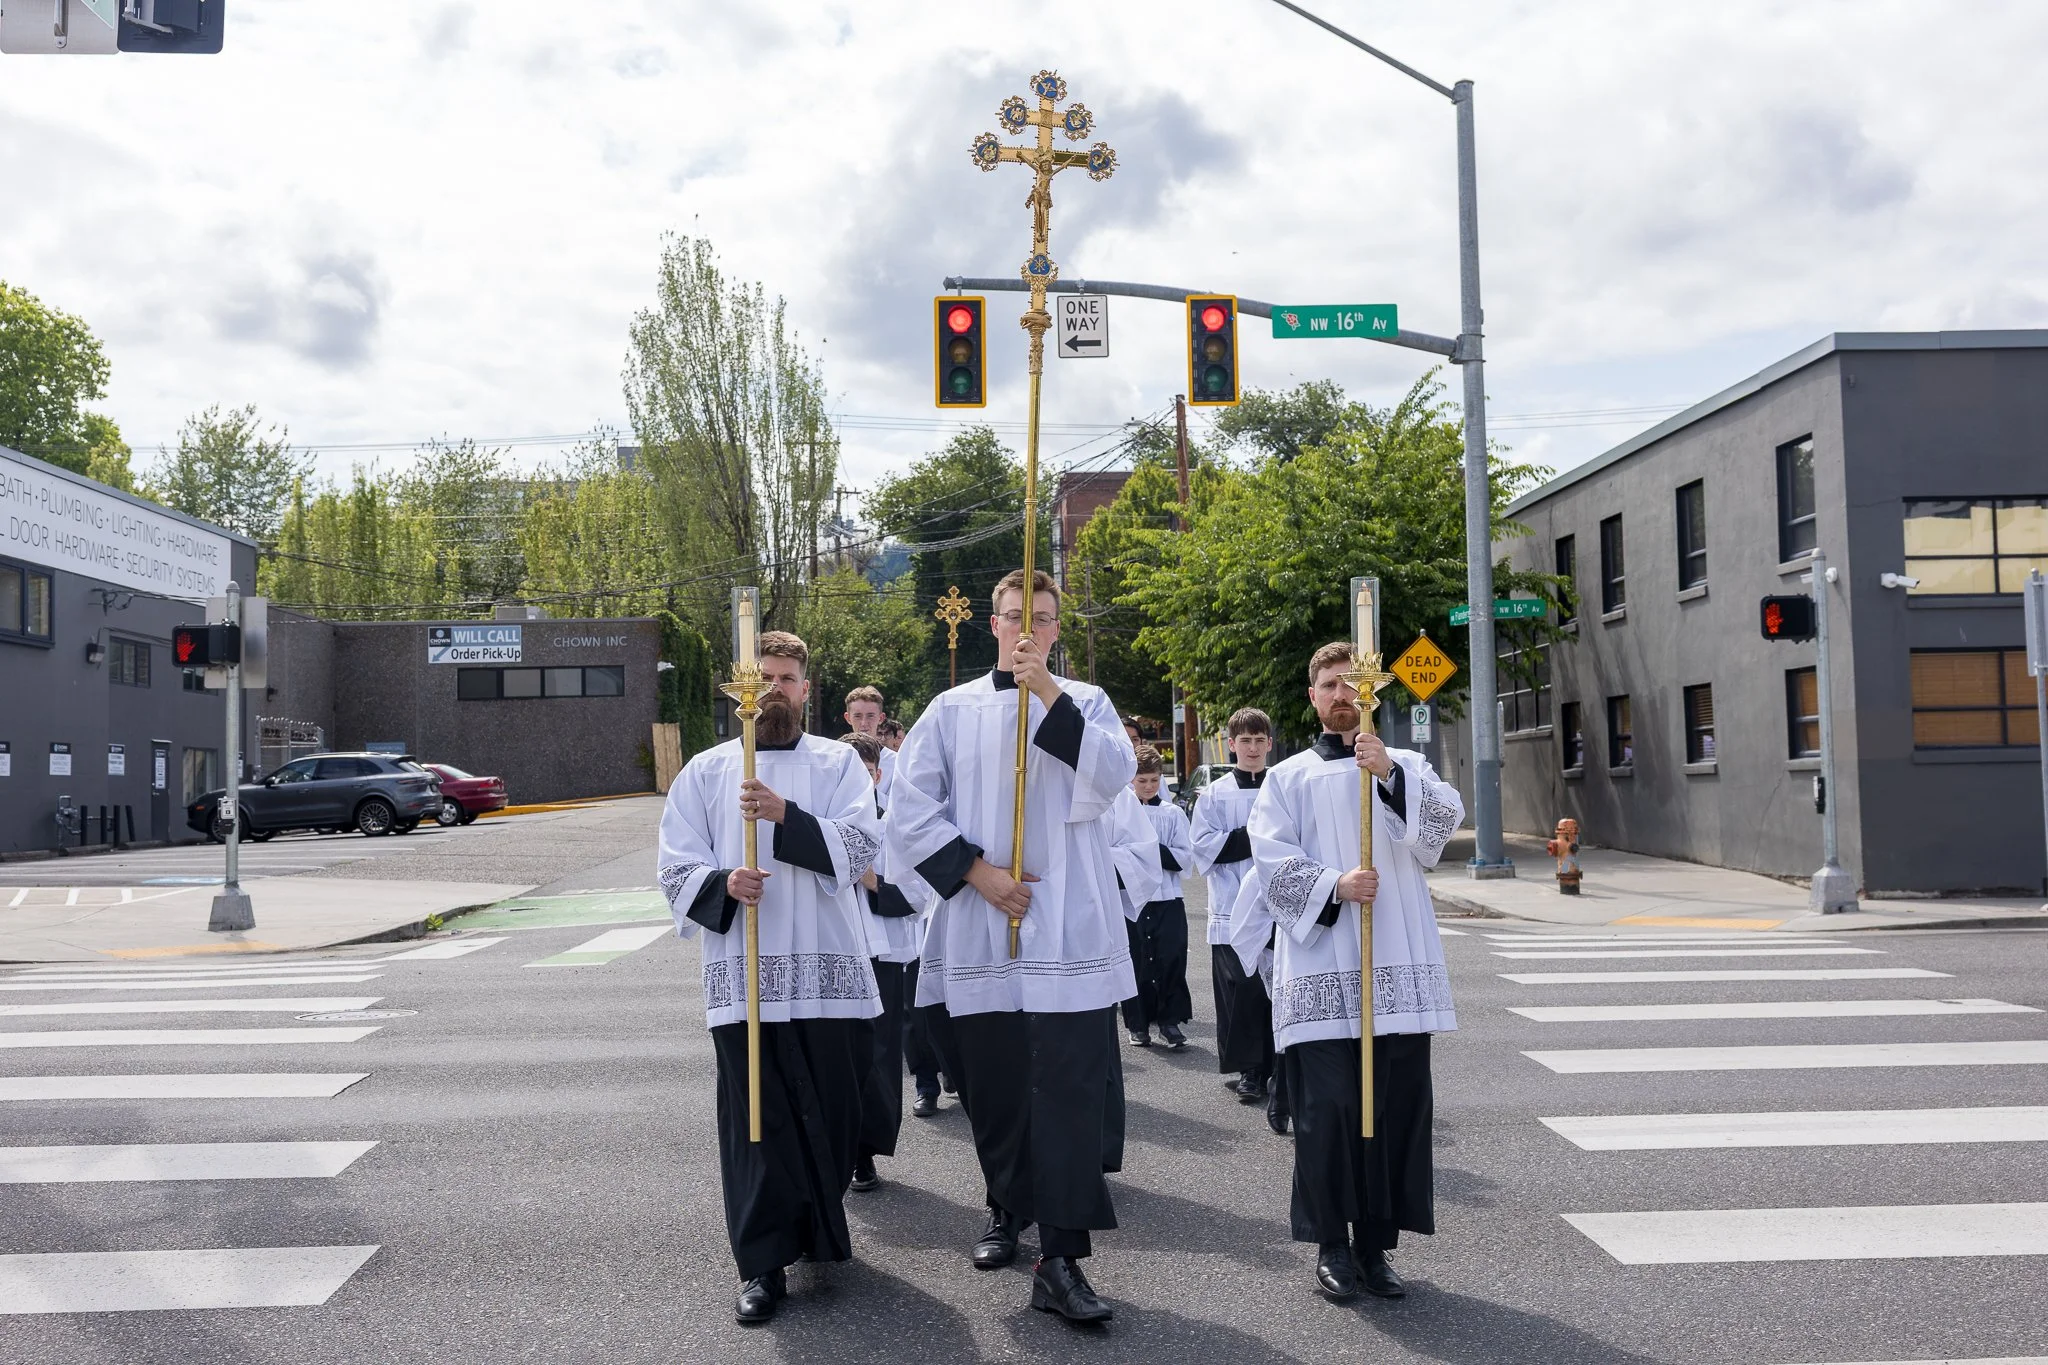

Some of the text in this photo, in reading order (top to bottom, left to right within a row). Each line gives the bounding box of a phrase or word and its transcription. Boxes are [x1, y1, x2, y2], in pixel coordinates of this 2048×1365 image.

[1066, 300, 1099, 315] ONE
[1065, 317, 1099, 331] WAY
[1310, 311, 1387, 332] NW 16th Av
[0, 472, 218, 566] BATH PLUMBING LIGHTING HARDWARE
[10, 516, 216, 596] DOOR HARDWARE SECURITY SYSTEMS
[453, 629, 520, 643] WILL CALL
[553, 636, 628, 648] CHOWN INC
[451, 648, 521, 661] Order Pick-Up
[1405, 656, 1442, 667] DEAD
[1411, 673, 1437, 684] END
